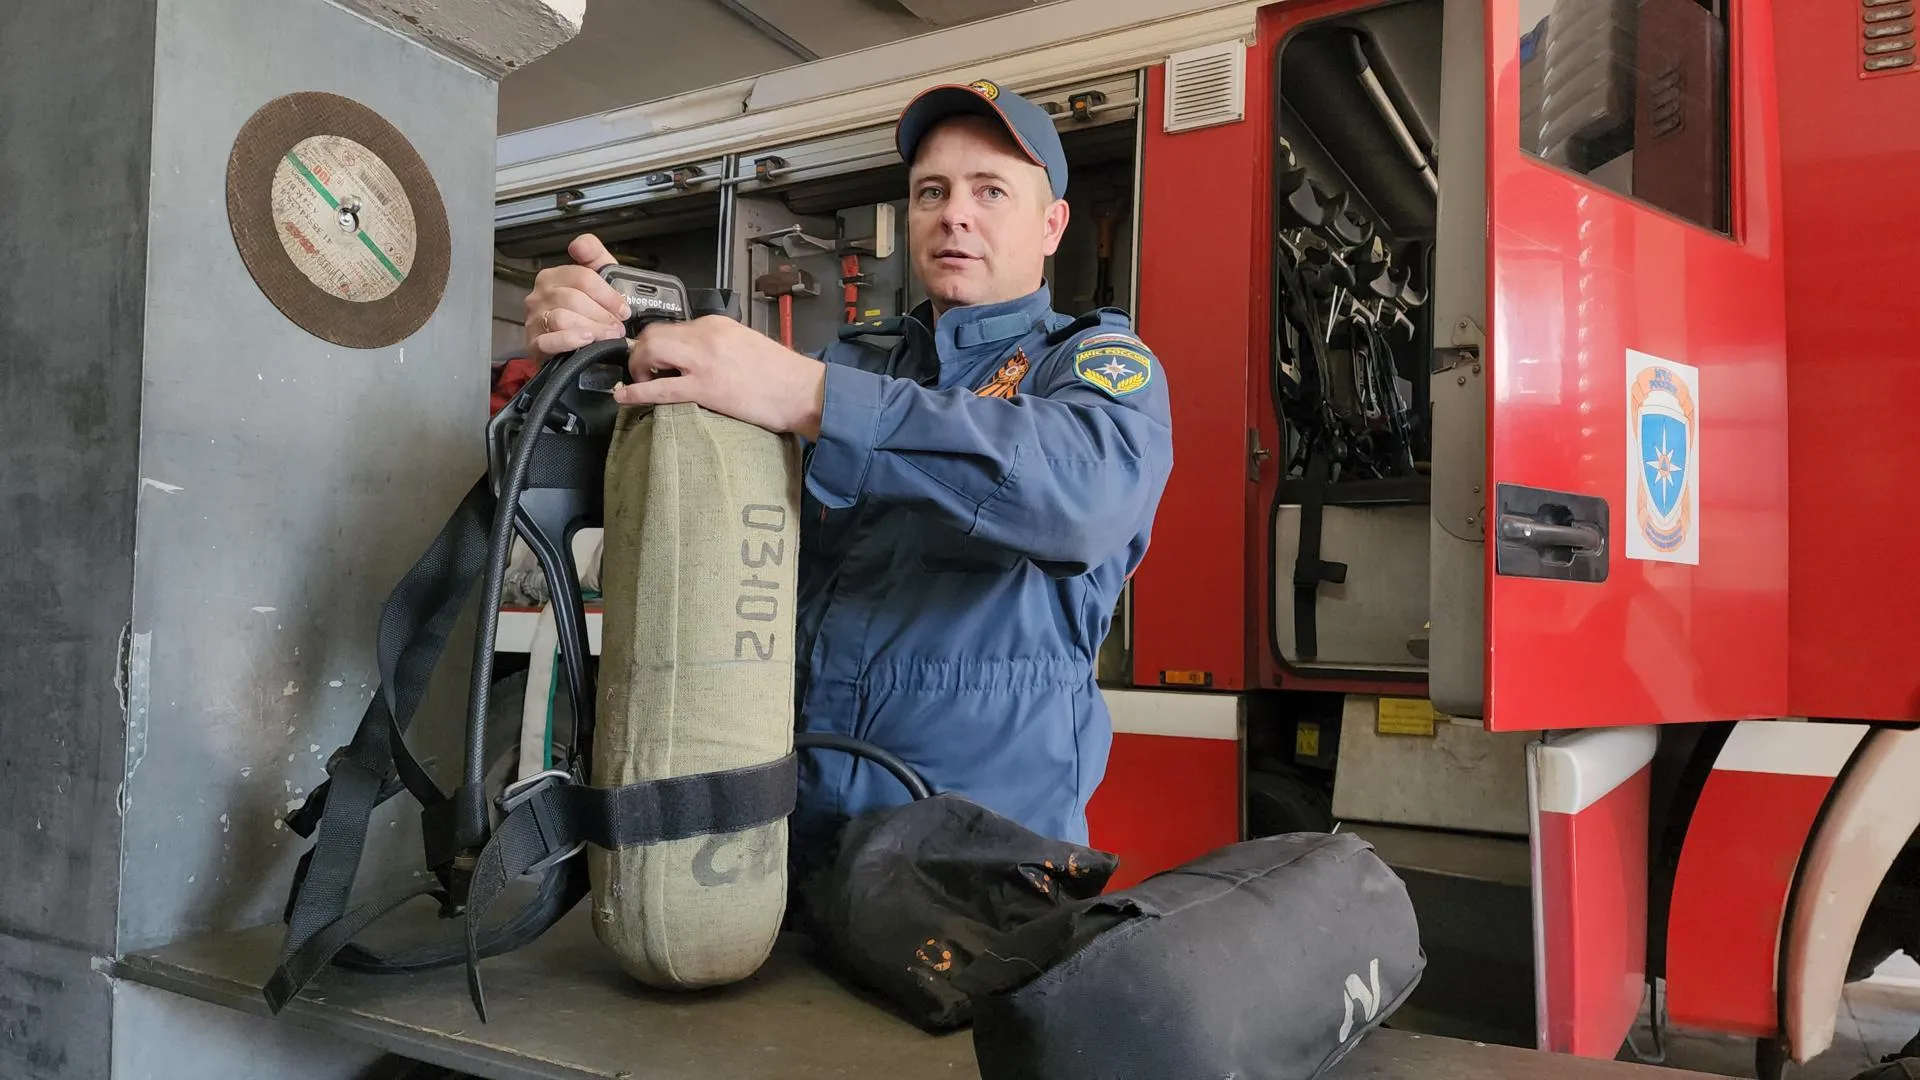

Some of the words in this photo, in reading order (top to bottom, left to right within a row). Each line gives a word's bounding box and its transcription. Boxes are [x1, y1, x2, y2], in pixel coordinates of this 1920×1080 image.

[1080, 349, 1103, 361] МЧС
[1105, 347, 1149, 367] РОССИИ
[735, 503, 786, 661] 03102
